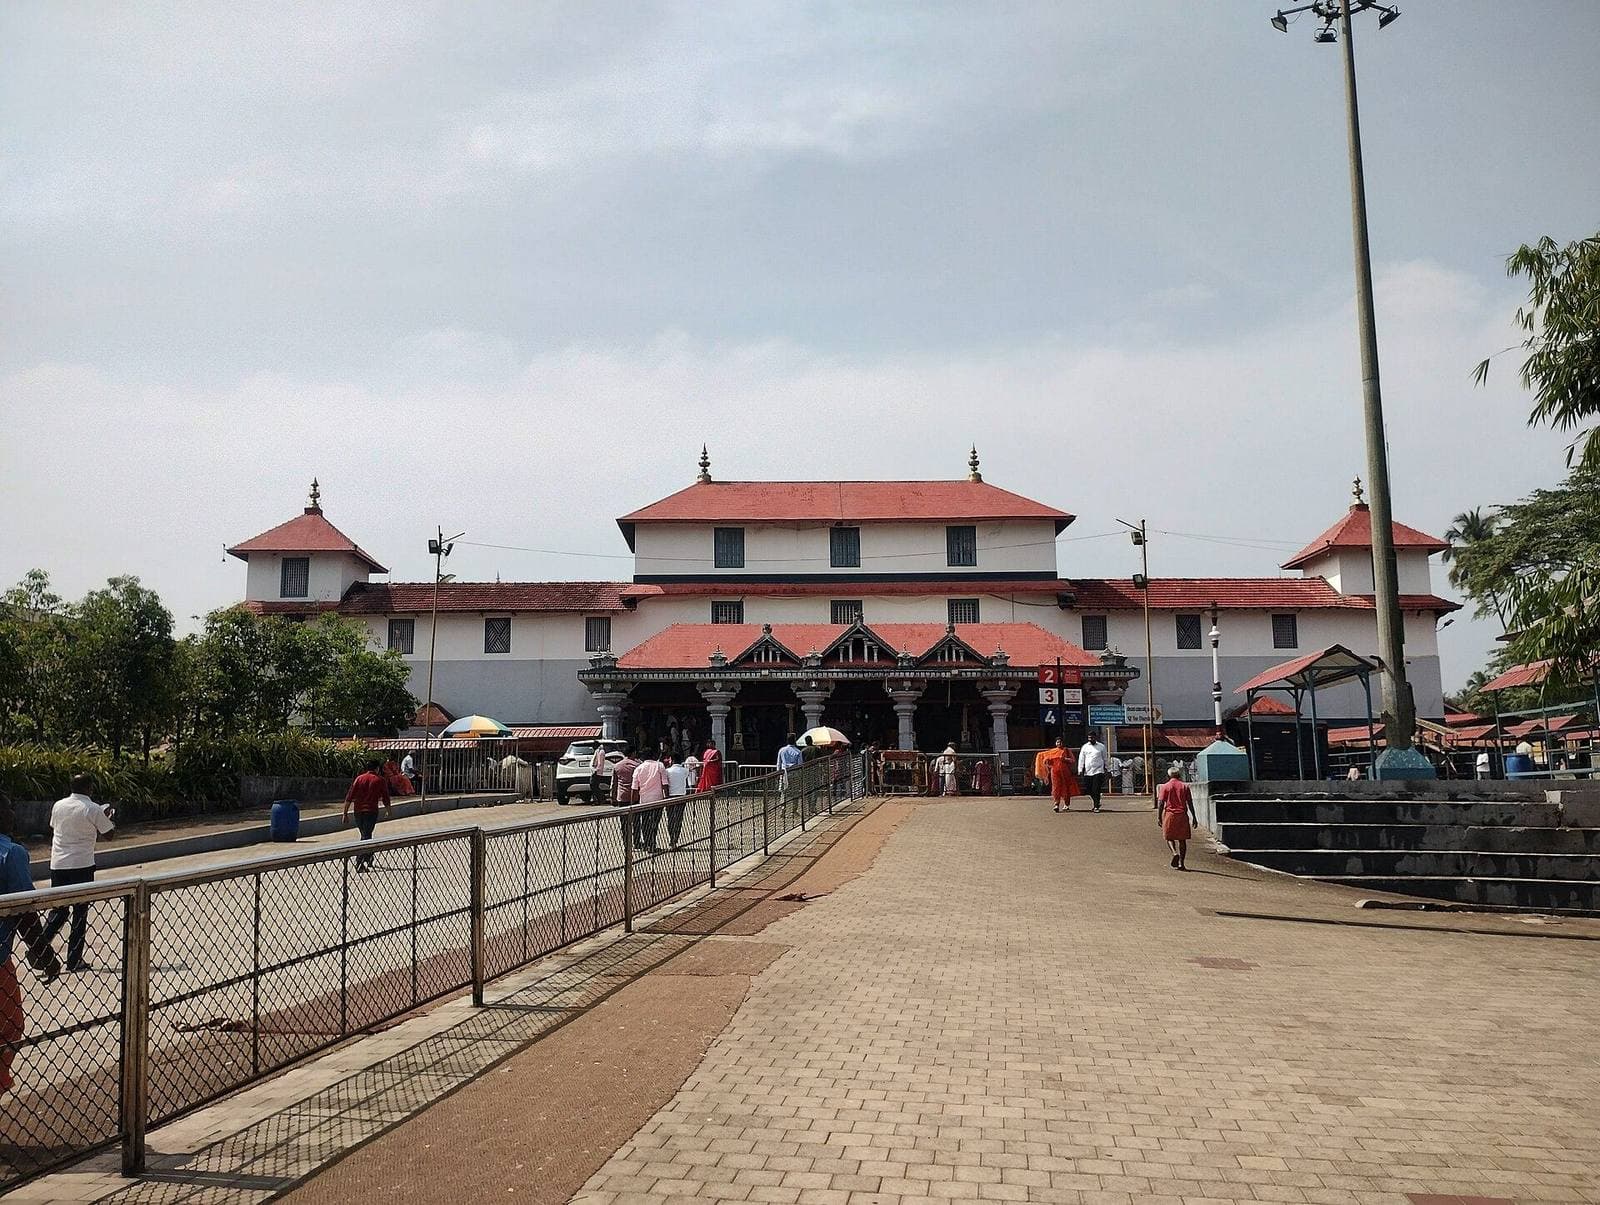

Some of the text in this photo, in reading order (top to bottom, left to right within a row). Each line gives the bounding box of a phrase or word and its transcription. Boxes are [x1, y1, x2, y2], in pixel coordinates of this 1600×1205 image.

[1044, 669, 1054, 683] 2
[1045, 690, 1054, 702] 3
[1044, 710, 1056, 724] 4
